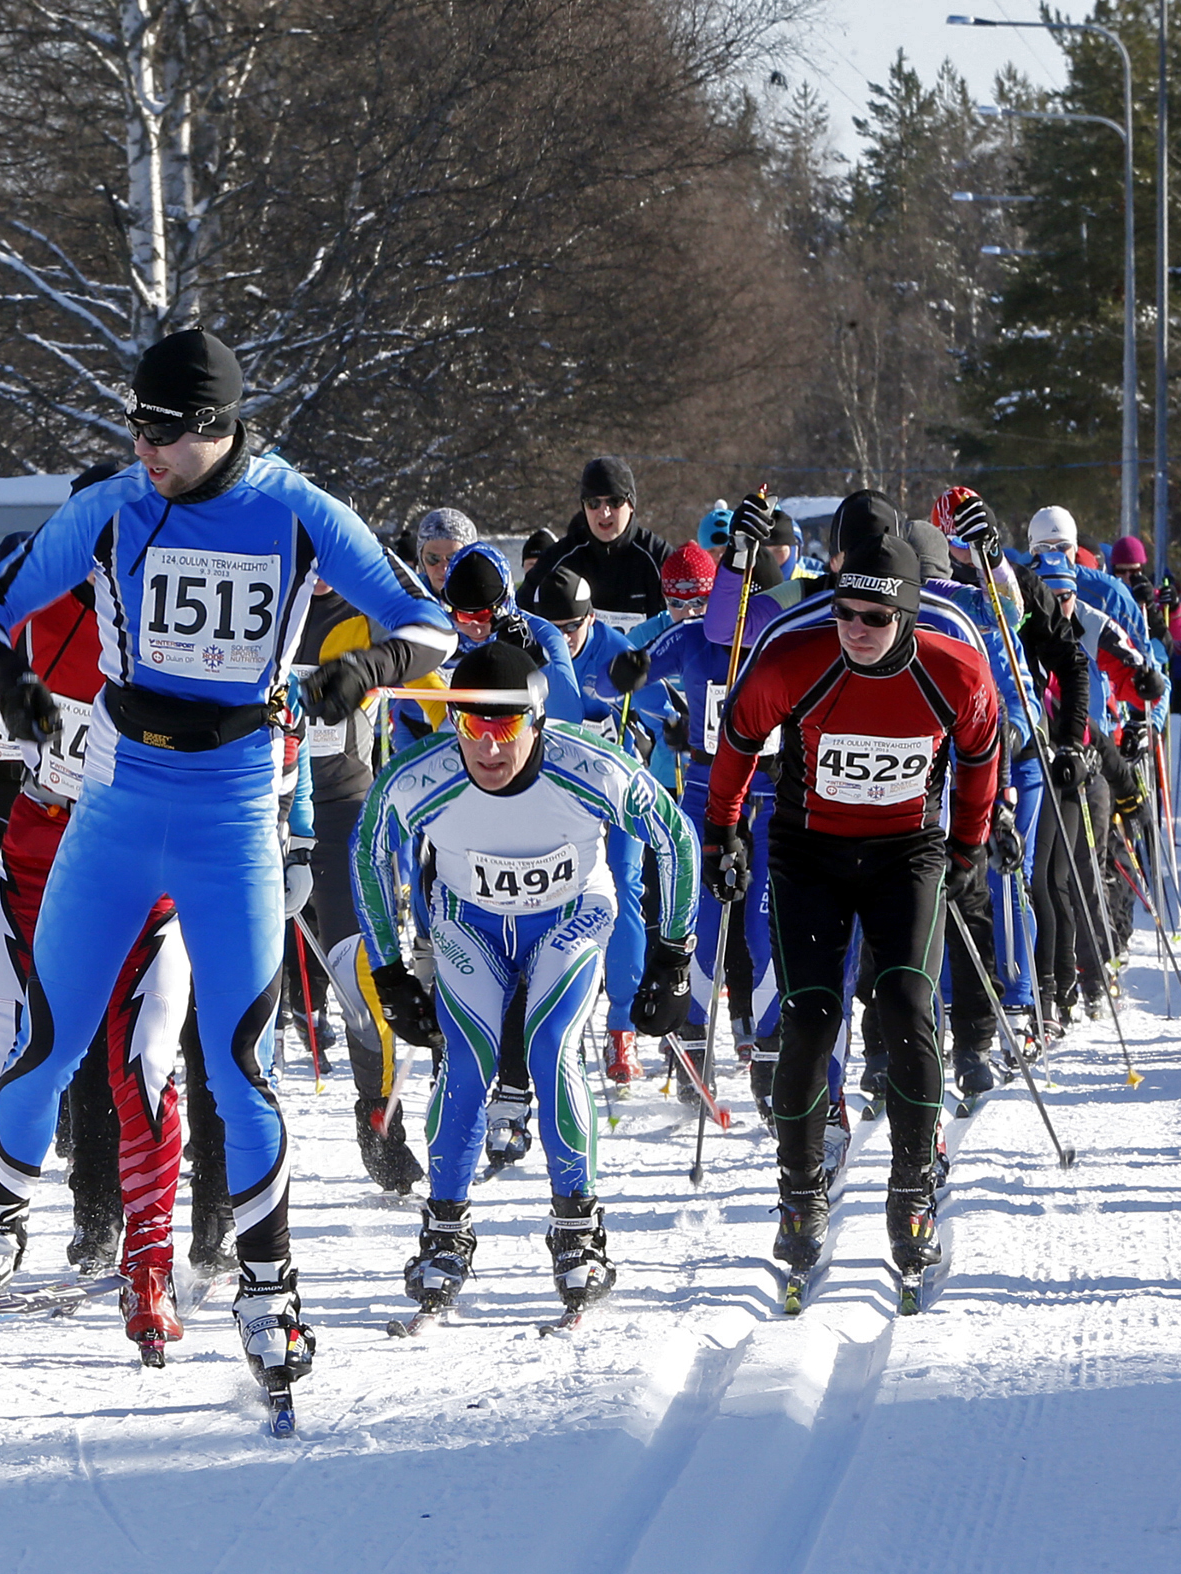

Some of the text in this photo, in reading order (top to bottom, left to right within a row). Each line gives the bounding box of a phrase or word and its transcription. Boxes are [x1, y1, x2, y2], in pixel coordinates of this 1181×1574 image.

[146, 404, 184, 418] INTERSPORT
[211, 559, 268, 572] TERVAHIIHTO
[839, 573, 903, 597] OPTIWAX
[148, 574, 274, 641] 1513
[155, 640, 196, 649] INTERSPORT
[73, 708, 91, 717] OULU
[50, 719, 90, 769] 14
[819, 749, 928, 783] 4529
[475, 858, 576, 898] 1494
[550, 906, 609, 952] FUTURE
[243, 1284, 284, 1292] SALOMON
